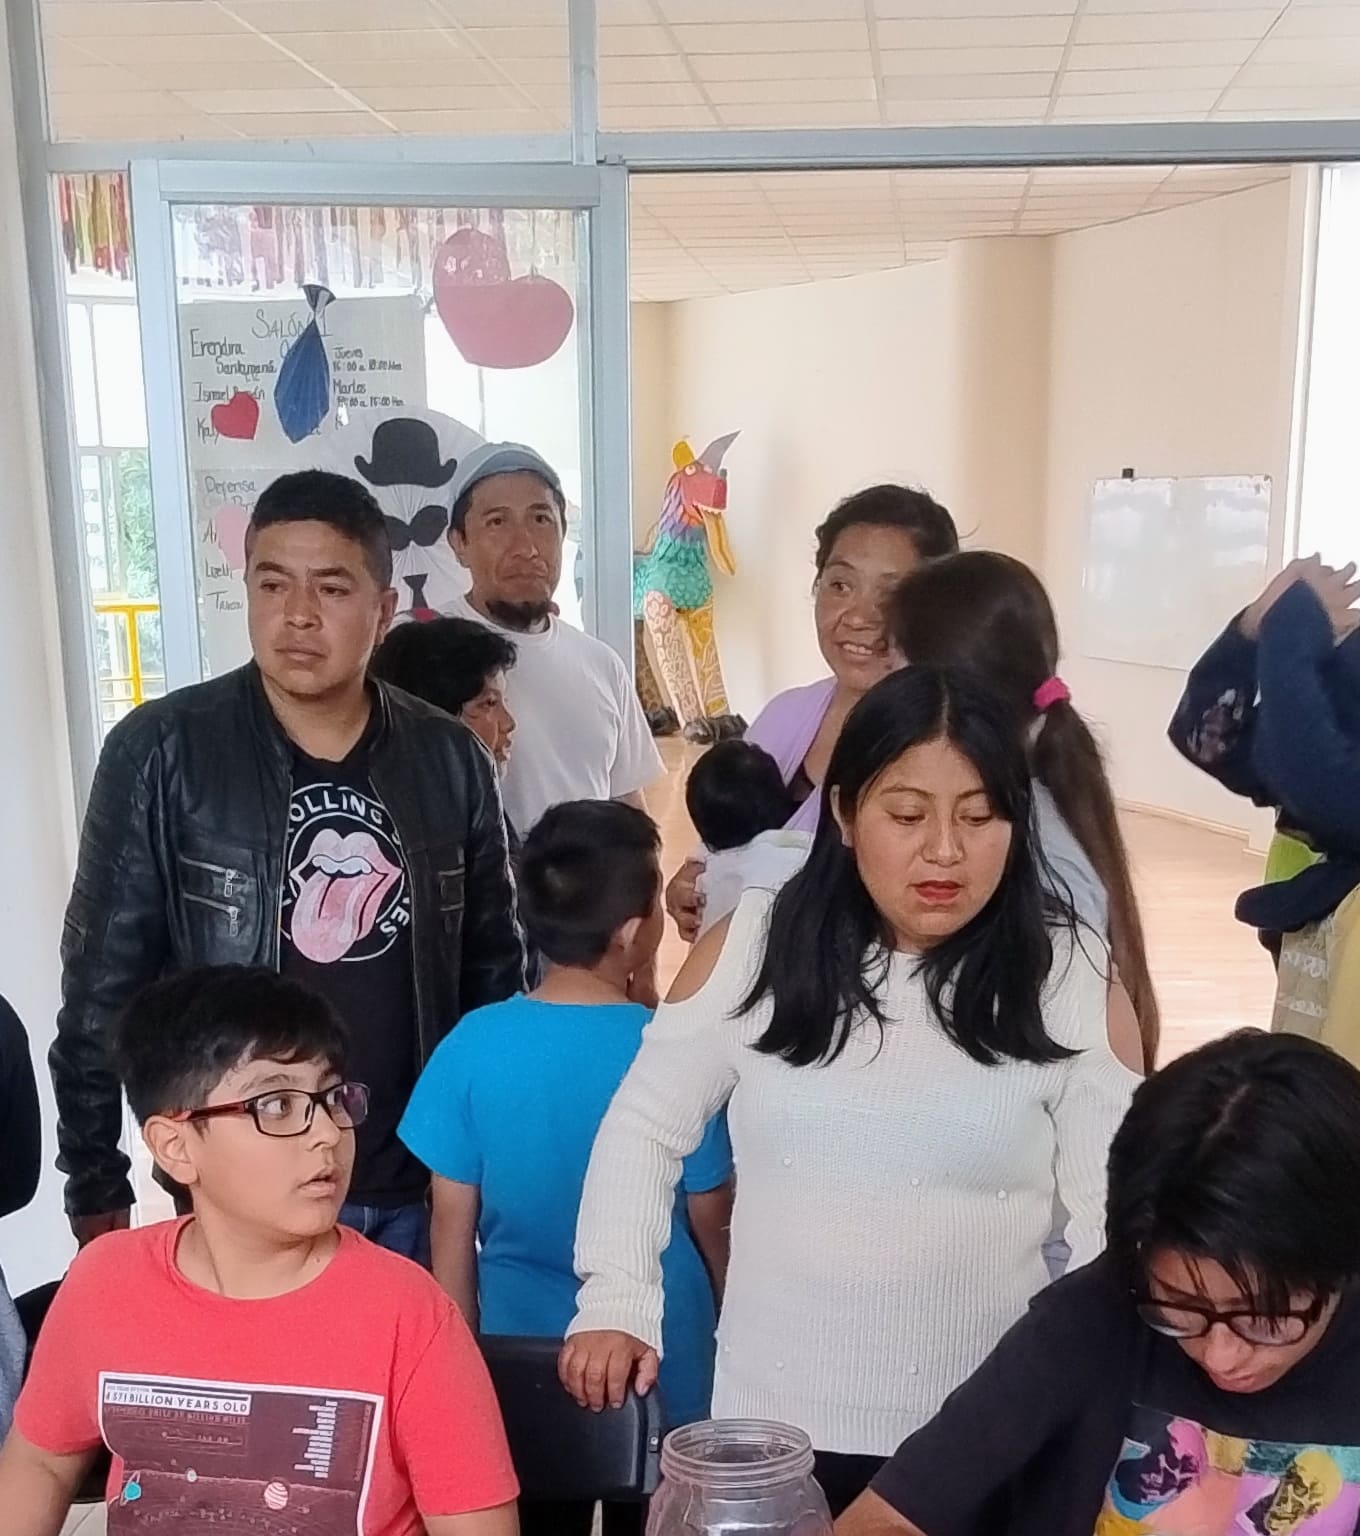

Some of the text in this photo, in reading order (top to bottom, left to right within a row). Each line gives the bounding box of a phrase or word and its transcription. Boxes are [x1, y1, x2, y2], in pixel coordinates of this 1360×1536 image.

[288, 789, 384, 834] OLLING
[129, 1392, 173, 1407] BILLION
[177, 1397, 220, 1411] YEARS
[223, 1401, 248, 1413] OLD
